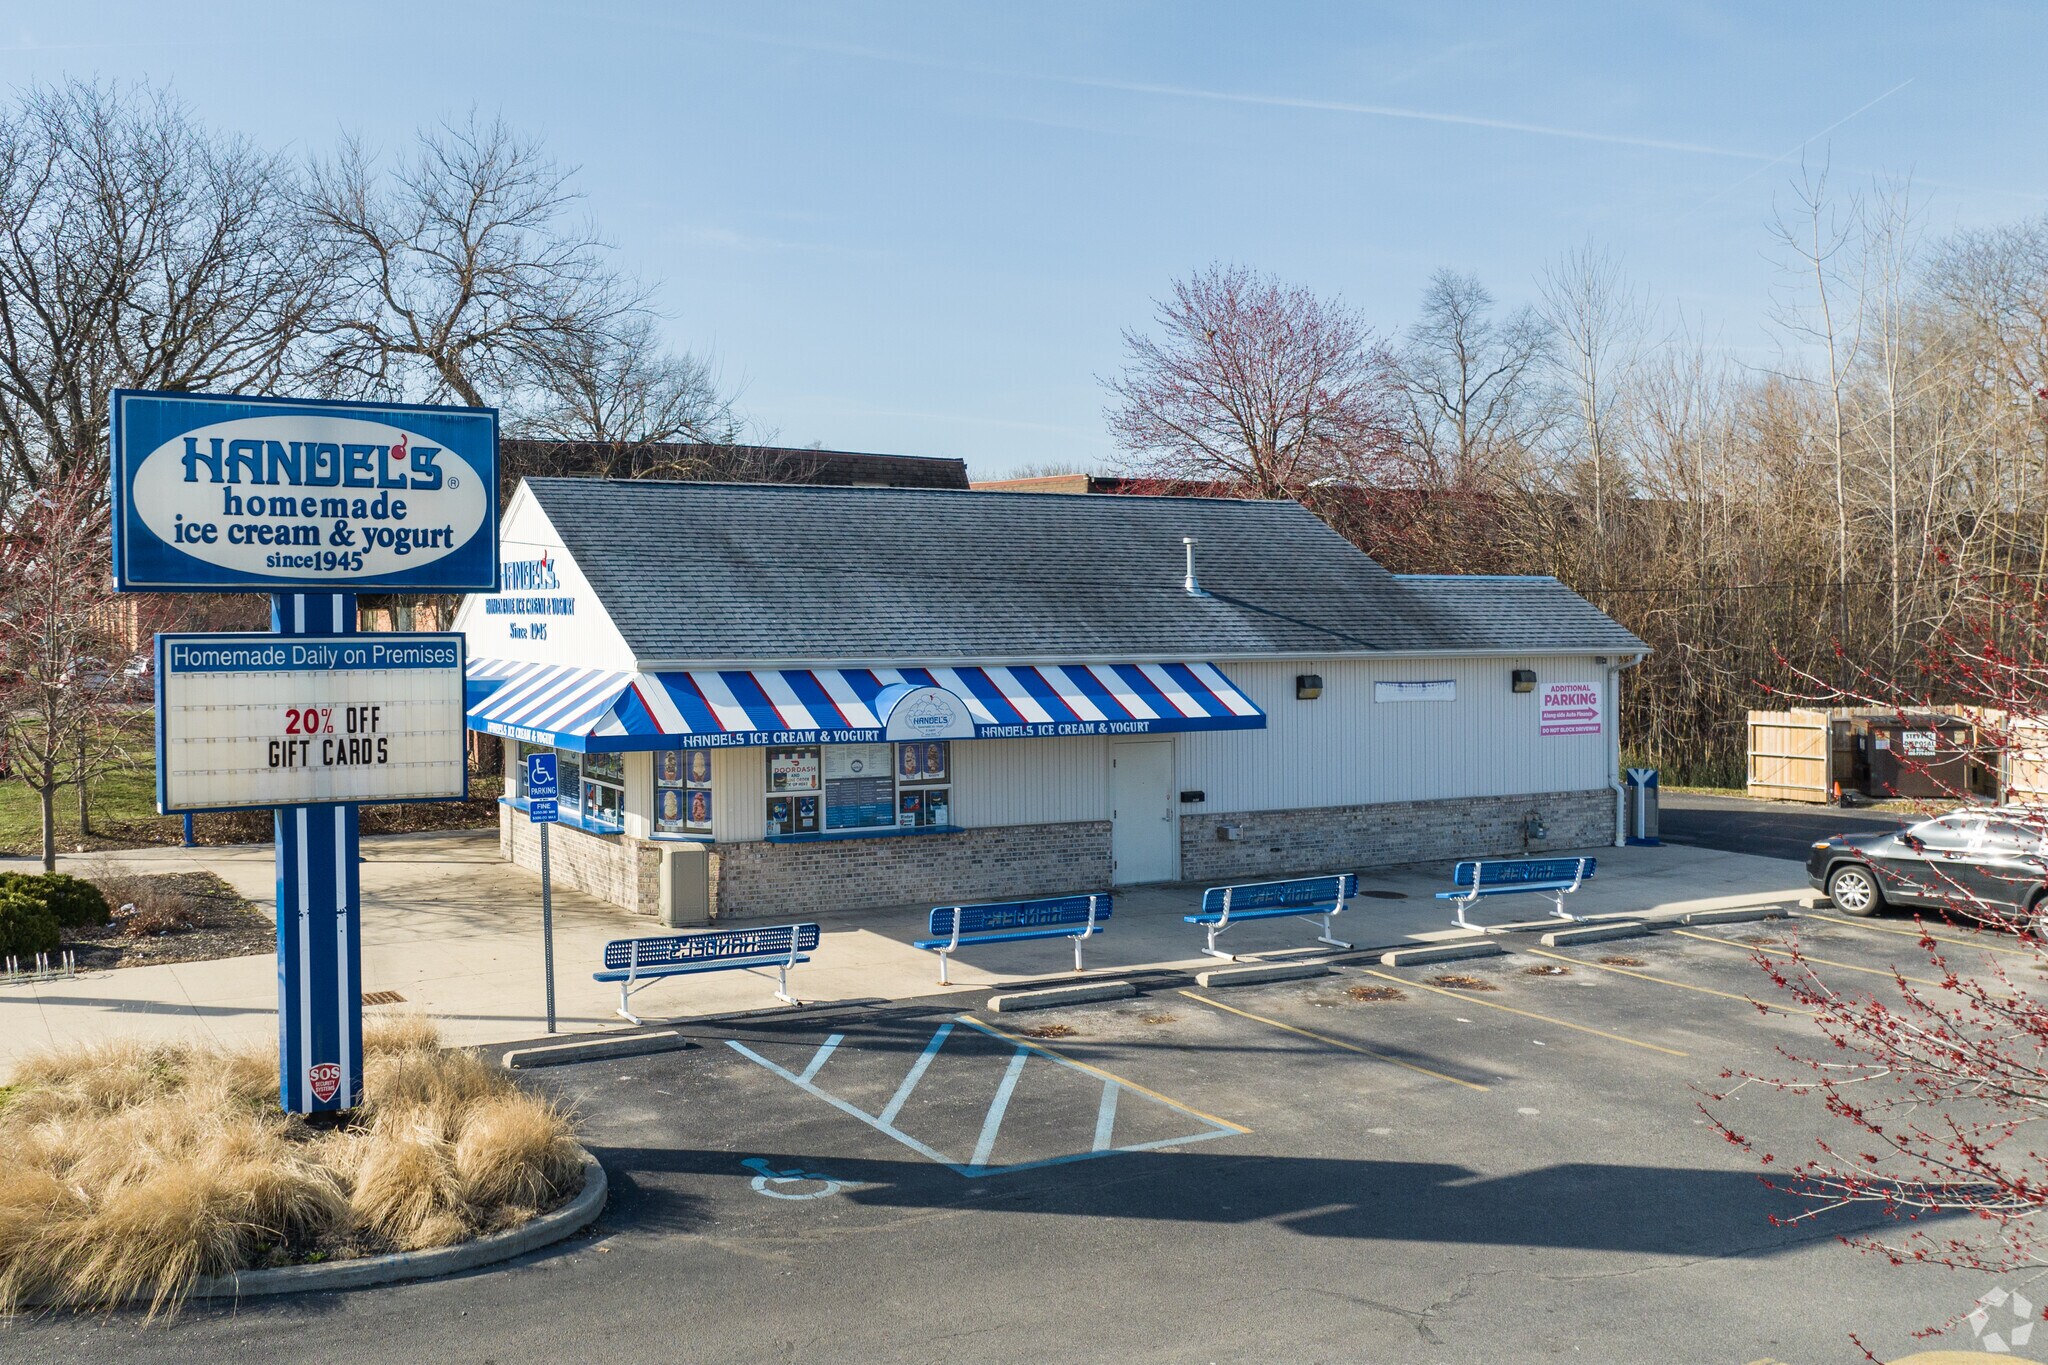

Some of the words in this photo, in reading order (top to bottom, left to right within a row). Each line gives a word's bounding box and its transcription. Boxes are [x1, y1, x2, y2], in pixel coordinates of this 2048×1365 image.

[222, 486, 407, 520] homemade
[174, 514, 218, 544] ice
[228, 520, 320, 546] cream
[330, 520, 355, 547] &
[362, 524, 454, 554] yogurt
[510, 622, 527, 639] Since
[530, 623, 547, 640] 1945
[174, 646, 286, 667] Homemade
[292, 645, 338, 669] Daily
[344, 648, 366, 665] on
[373, 645, 455, 664] Premises
[1551, 684, 1591, 692] ADDITIONAL
[1544, 693, 1597, 706] PARKING
[285, 708, 334, 735] 20%
[346, 706, 380, 734] OFF
[1038, 724, 1055, 736] ICE
[1058, 723, 1095, 735] CREAM
[1098, 722, 1108, 733] &
[1110, 721, 1150, 733] YOGURT
[750, 733, 769, 744] ICE
[773, 731, 816, 744] CREAM
[819, 731, 831, 742] &
[835, 730, 879, 742] YOGURT
[268, 739, 310, 768] GIFT
[323, 737, 388, 766] CARDS
[531, 786, 556, 795] PARKING
[536, 802, 551, 810] FINE
[310, 1066, 340, 1081] SOS
